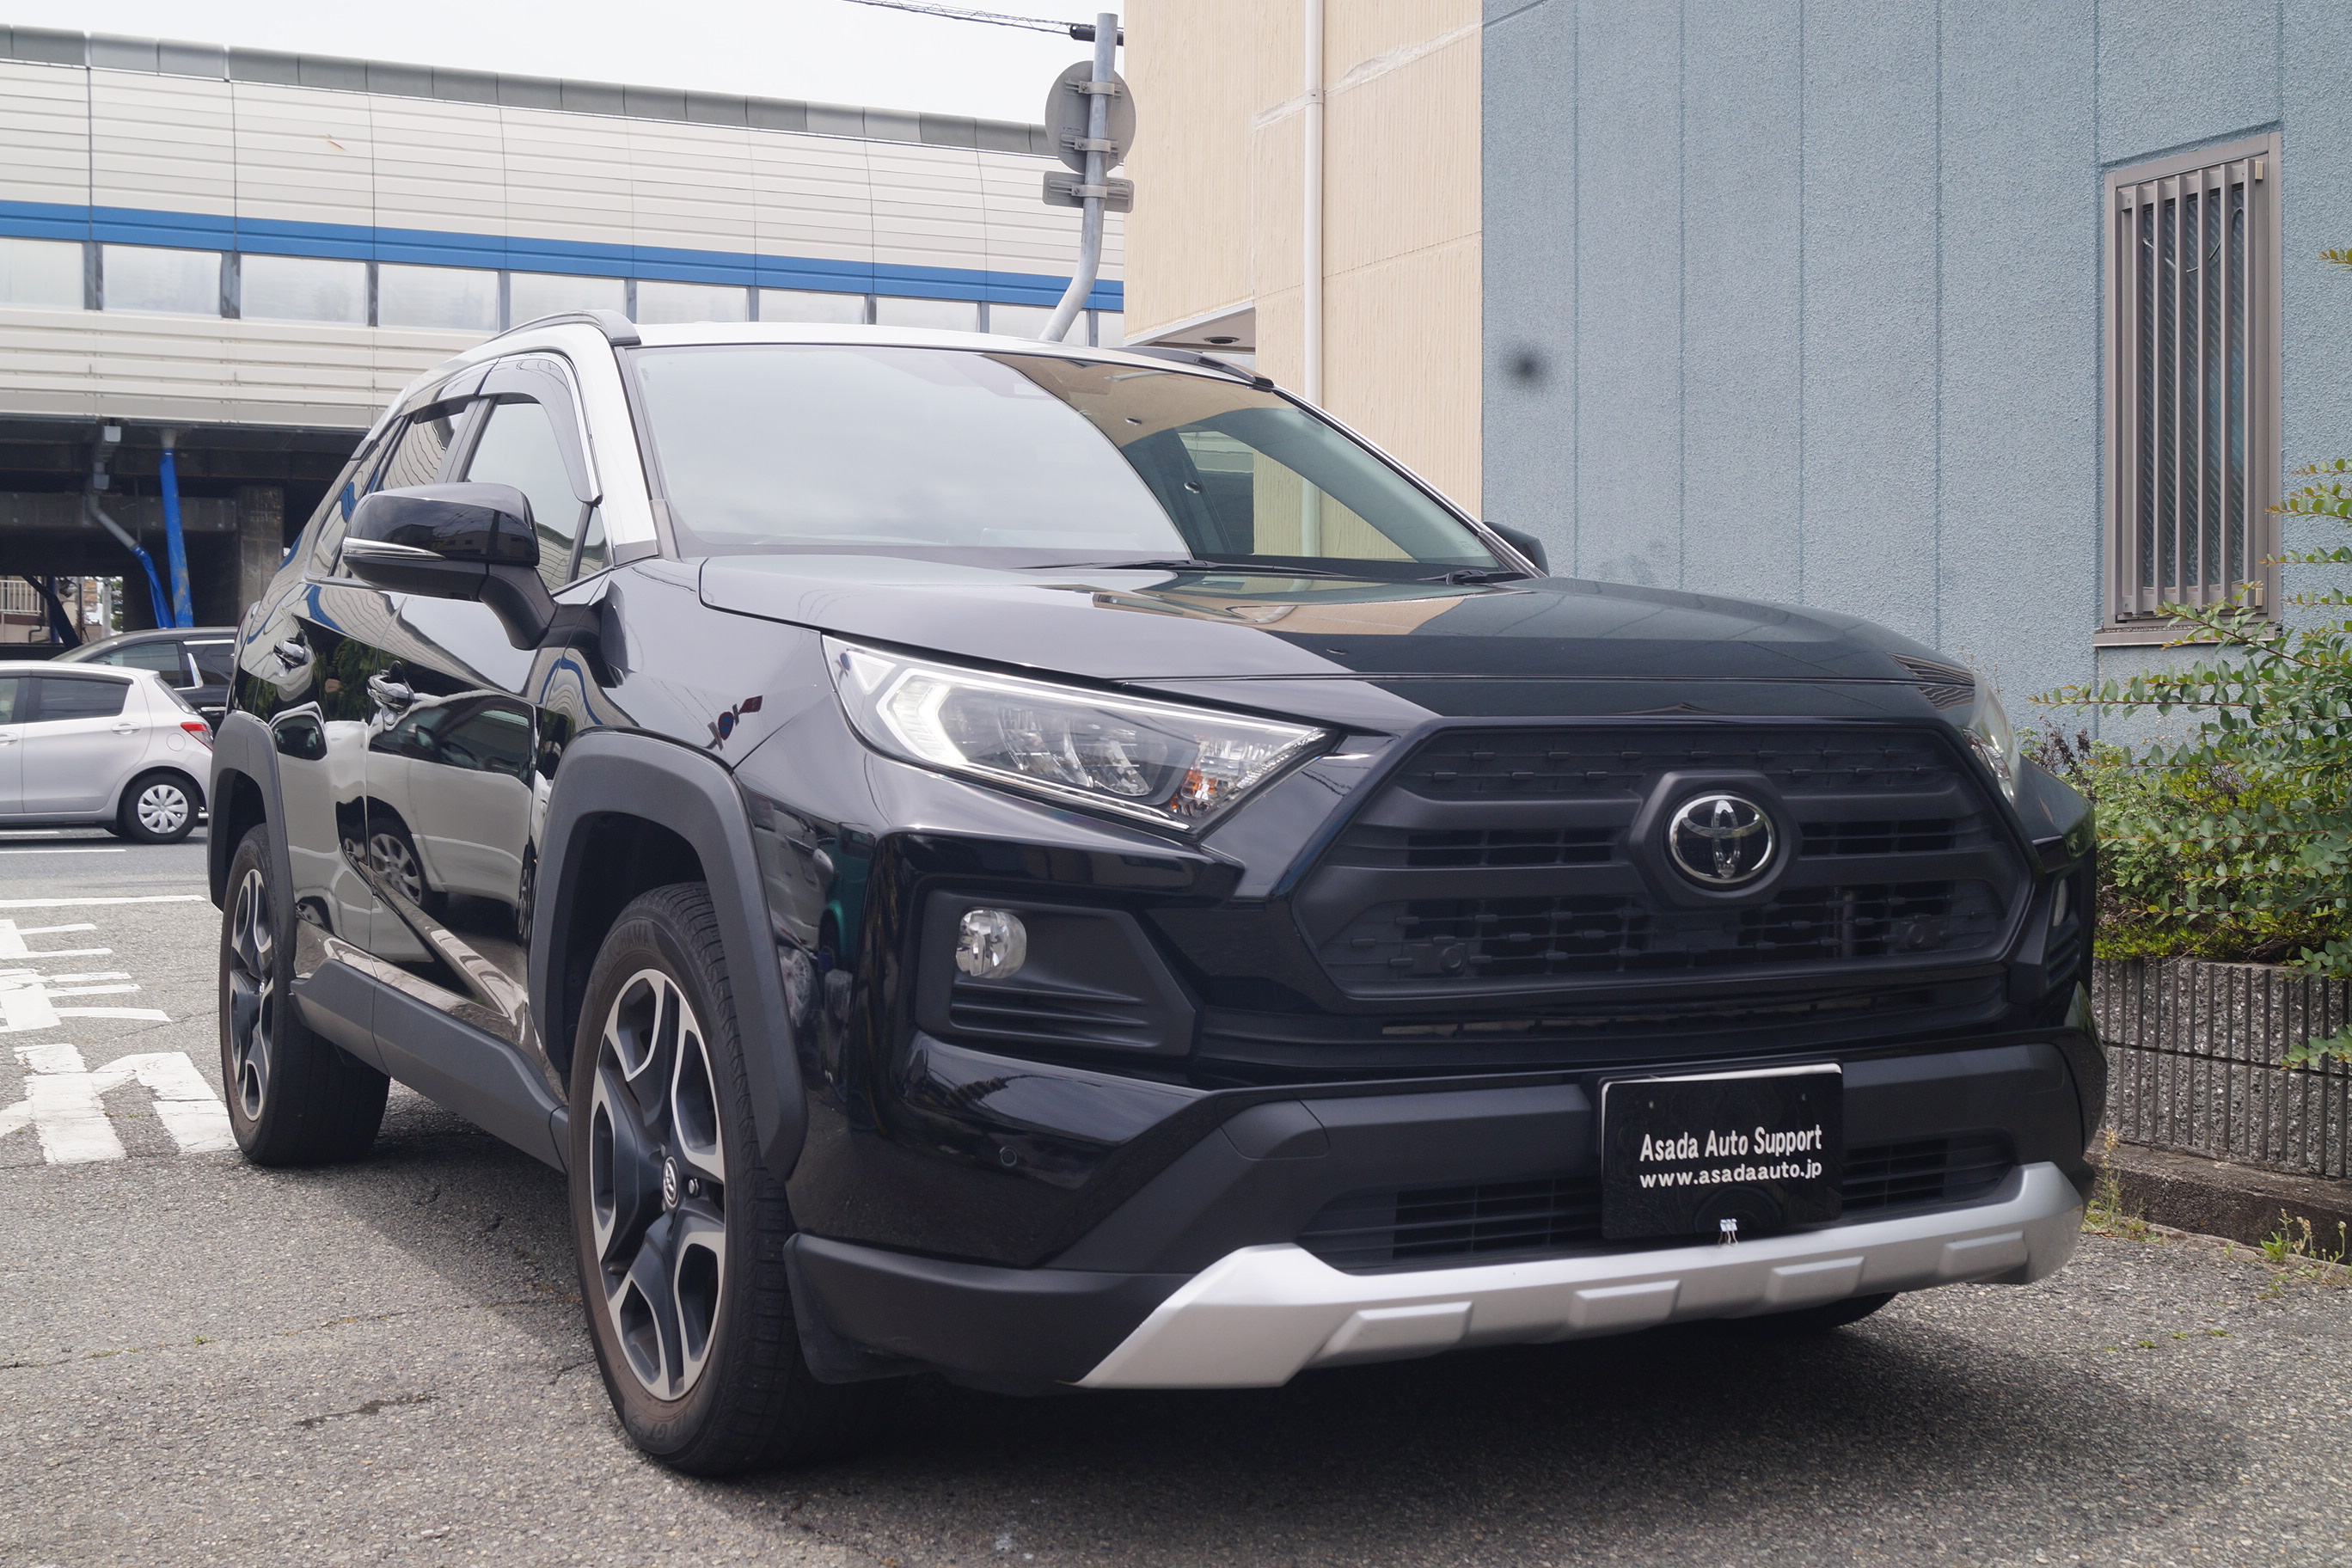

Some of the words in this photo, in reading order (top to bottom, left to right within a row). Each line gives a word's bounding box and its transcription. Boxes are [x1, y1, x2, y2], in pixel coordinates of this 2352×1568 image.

[1639, 1131, 1700, 1161] Asada
[1705, 1130, 1749, 1157] Auto
[1754, 1124, 1822, 1157] Support
[1639, 1158, 1822, 1188] www.asadaauto.jp
